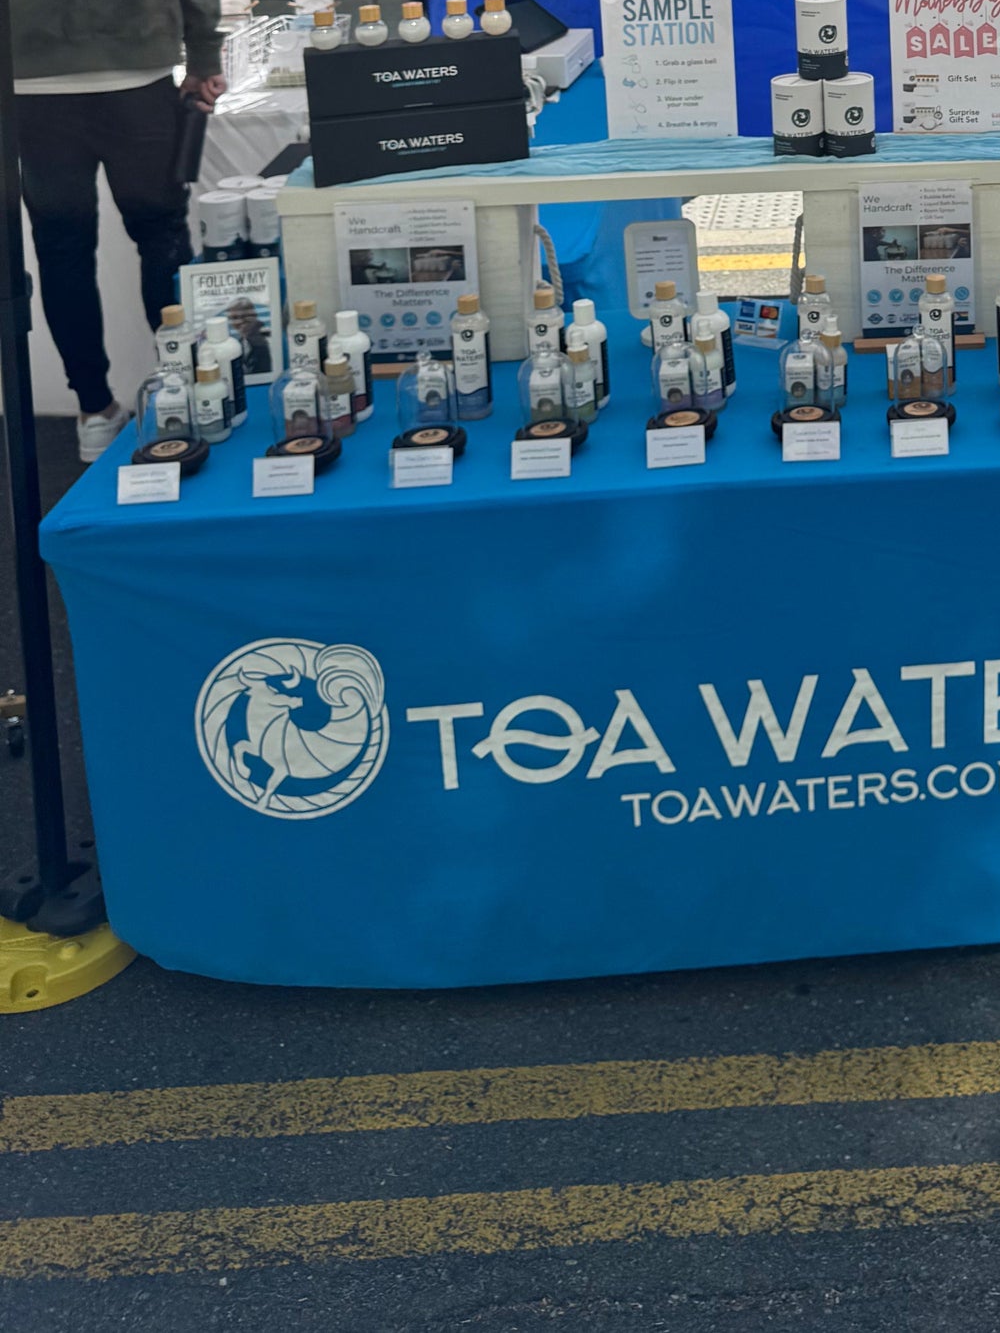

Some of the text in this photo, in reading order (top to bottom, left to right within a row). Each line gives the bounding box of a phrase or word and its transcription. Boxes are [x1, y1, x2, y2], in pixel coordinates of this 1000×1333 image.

[623, 21, 715, 47] STATION
[910, 32, 994, 51] SALE
[372, 65, 459, 82] TOA WATERS
[378, 139, 407, 151] TOA
[409, 133, 464, 148] WATERS
[863, 196, 880, 204] We
[863, 204, 912, 213] Handcraft
[349, 225, 401, 234] Handcraft
[884, 265, 955, 274] The Difference
[199, 273, 245, 287] FOLLOW
[901, 275, 926, 283] Matt
[374, 289, 450, 298] The Difference
[406, 688, 676, 792] TOA
